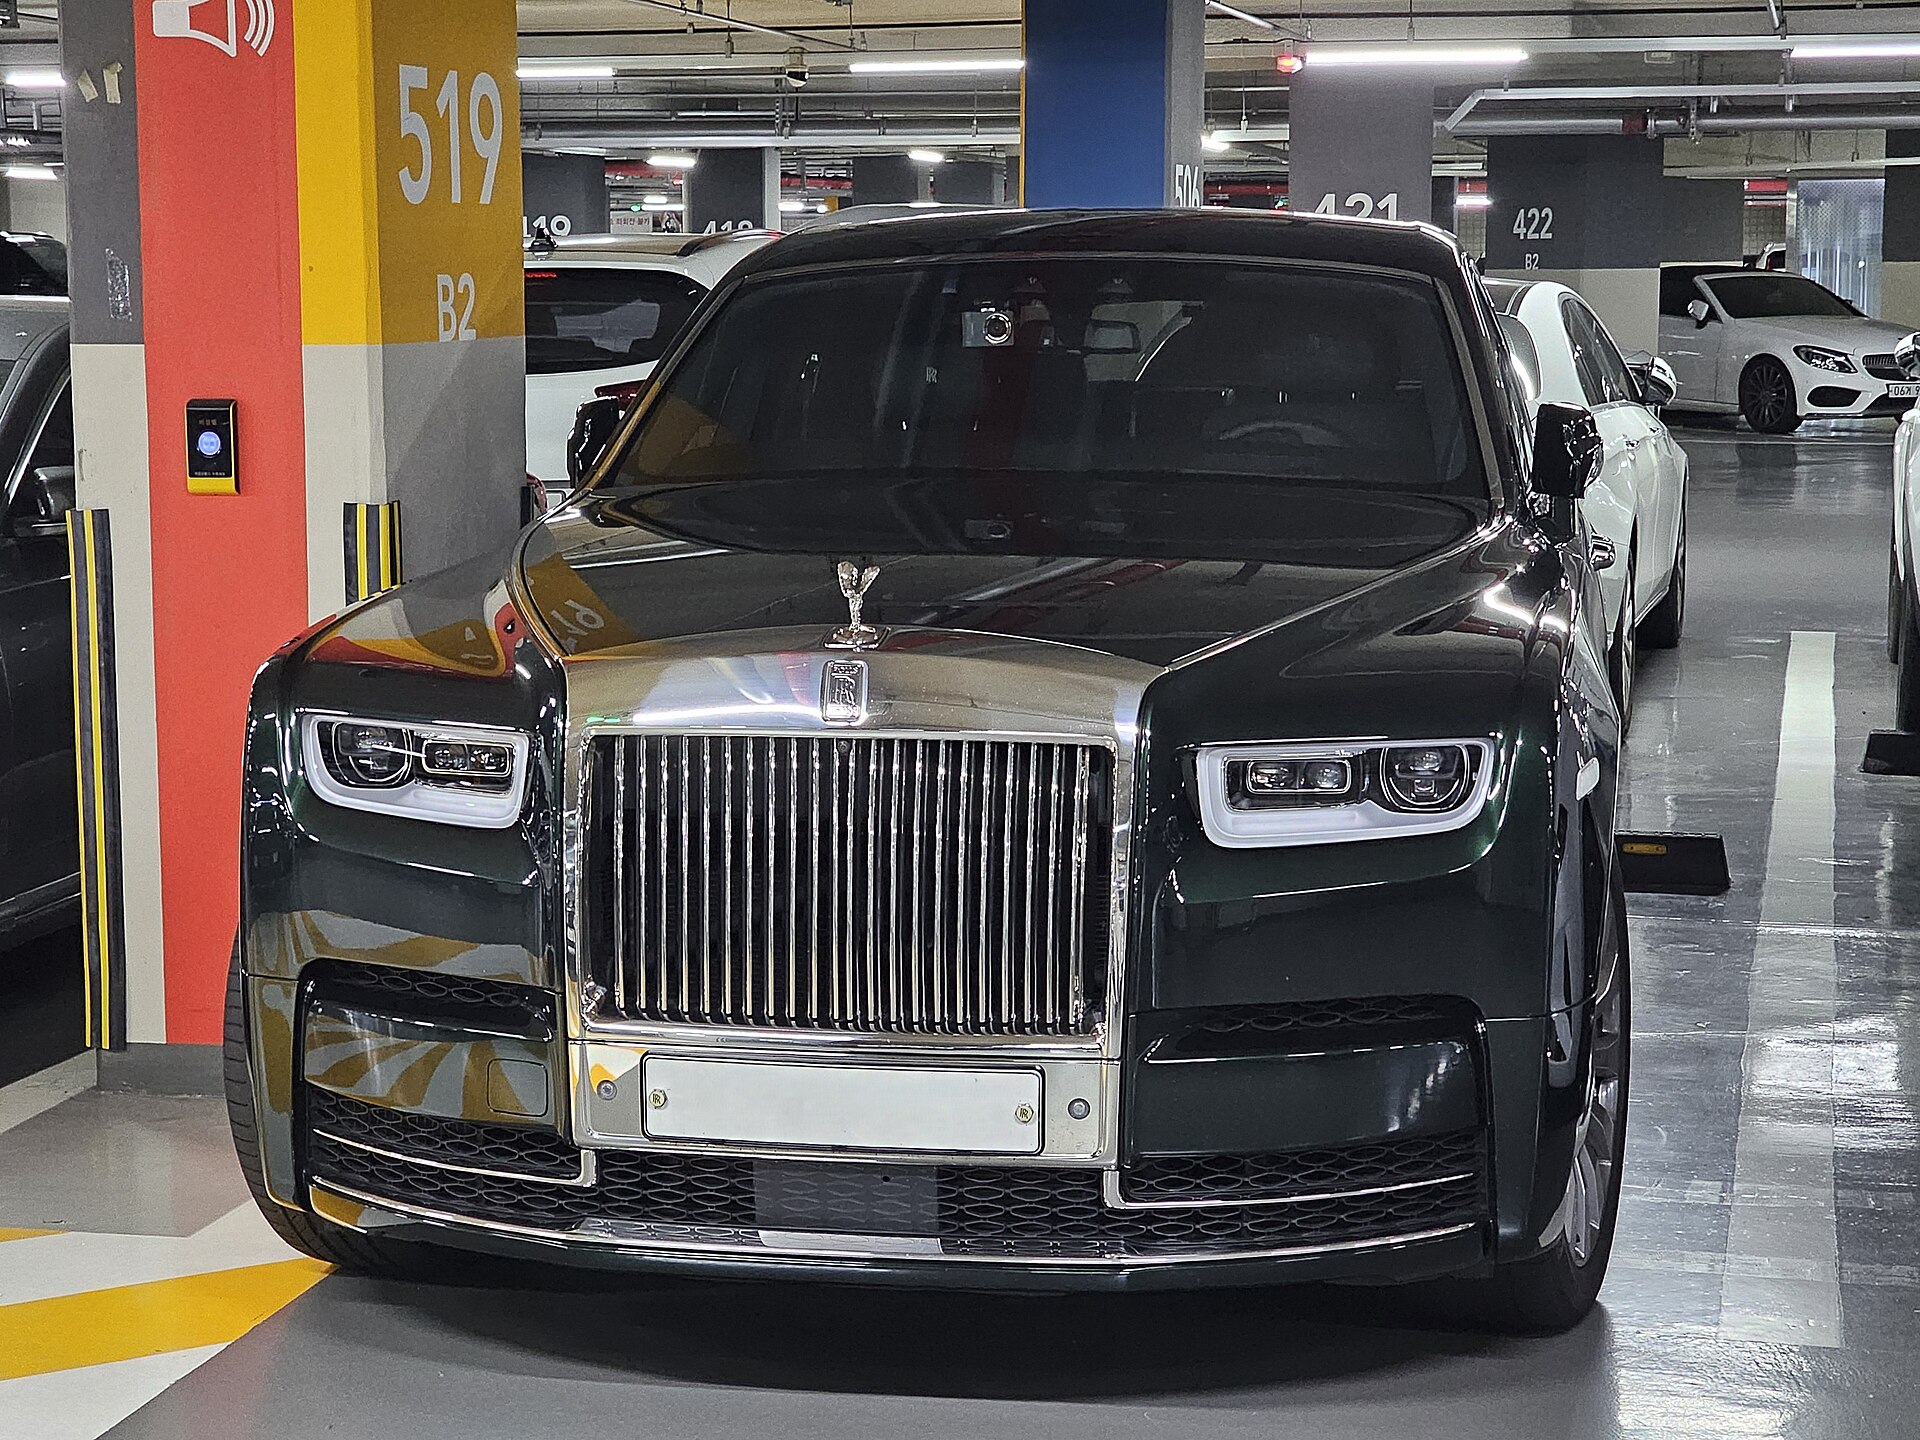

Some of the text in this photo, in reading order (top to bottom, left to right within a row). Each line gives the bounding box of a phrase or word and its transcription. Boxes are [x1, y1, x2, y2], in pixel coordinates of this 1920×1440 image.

[397, 64, 503, 205] 519
[1174, 163, 1200, 207] 506
[523, 215, 571, 237] 19
[1512, 207, 1553, 240] 422
[1525, 253, 1539, 270] B2
[437, 272, 477, 342] B2
